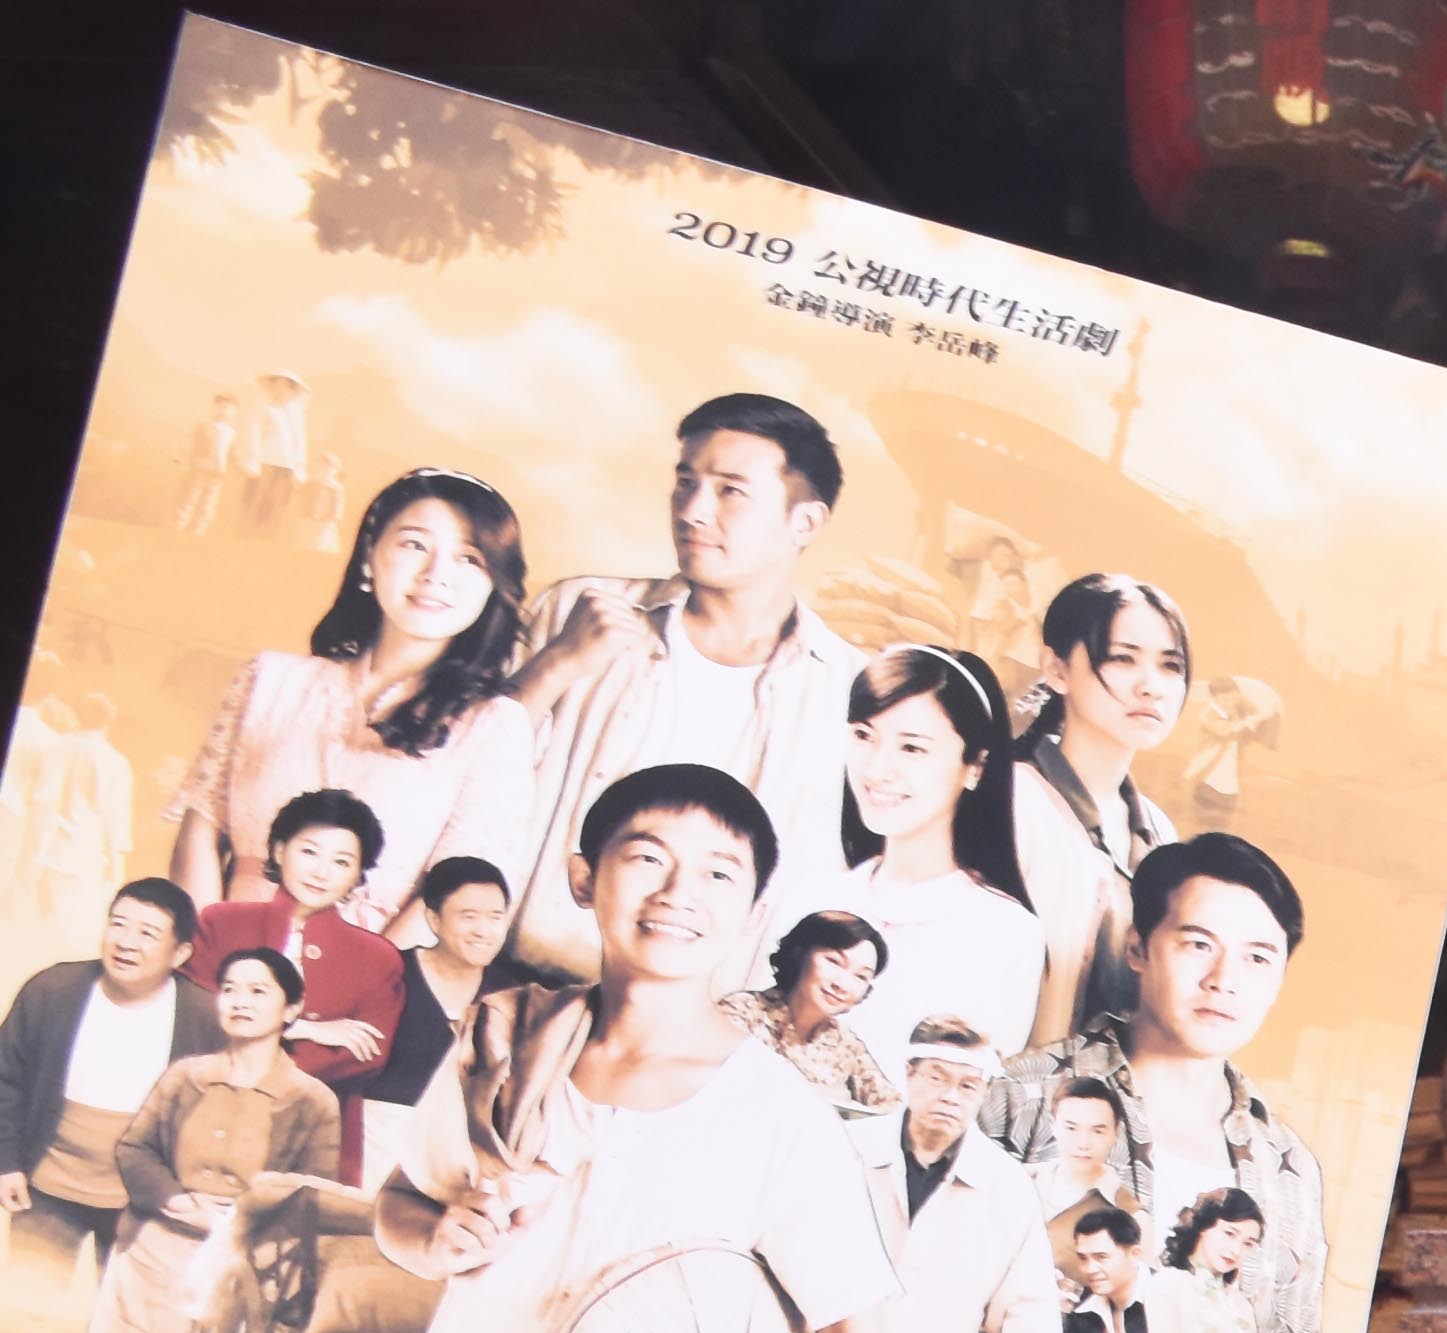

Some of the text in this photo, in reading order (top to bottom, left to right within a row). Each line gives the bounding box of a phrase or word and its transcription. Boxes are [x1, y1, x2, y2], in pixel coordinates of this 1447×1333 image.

[668, 212, 1120, 357] 2019 公視時代生活劇
[765, 282, 1000, 365] 金鐘導演 李岳峰
